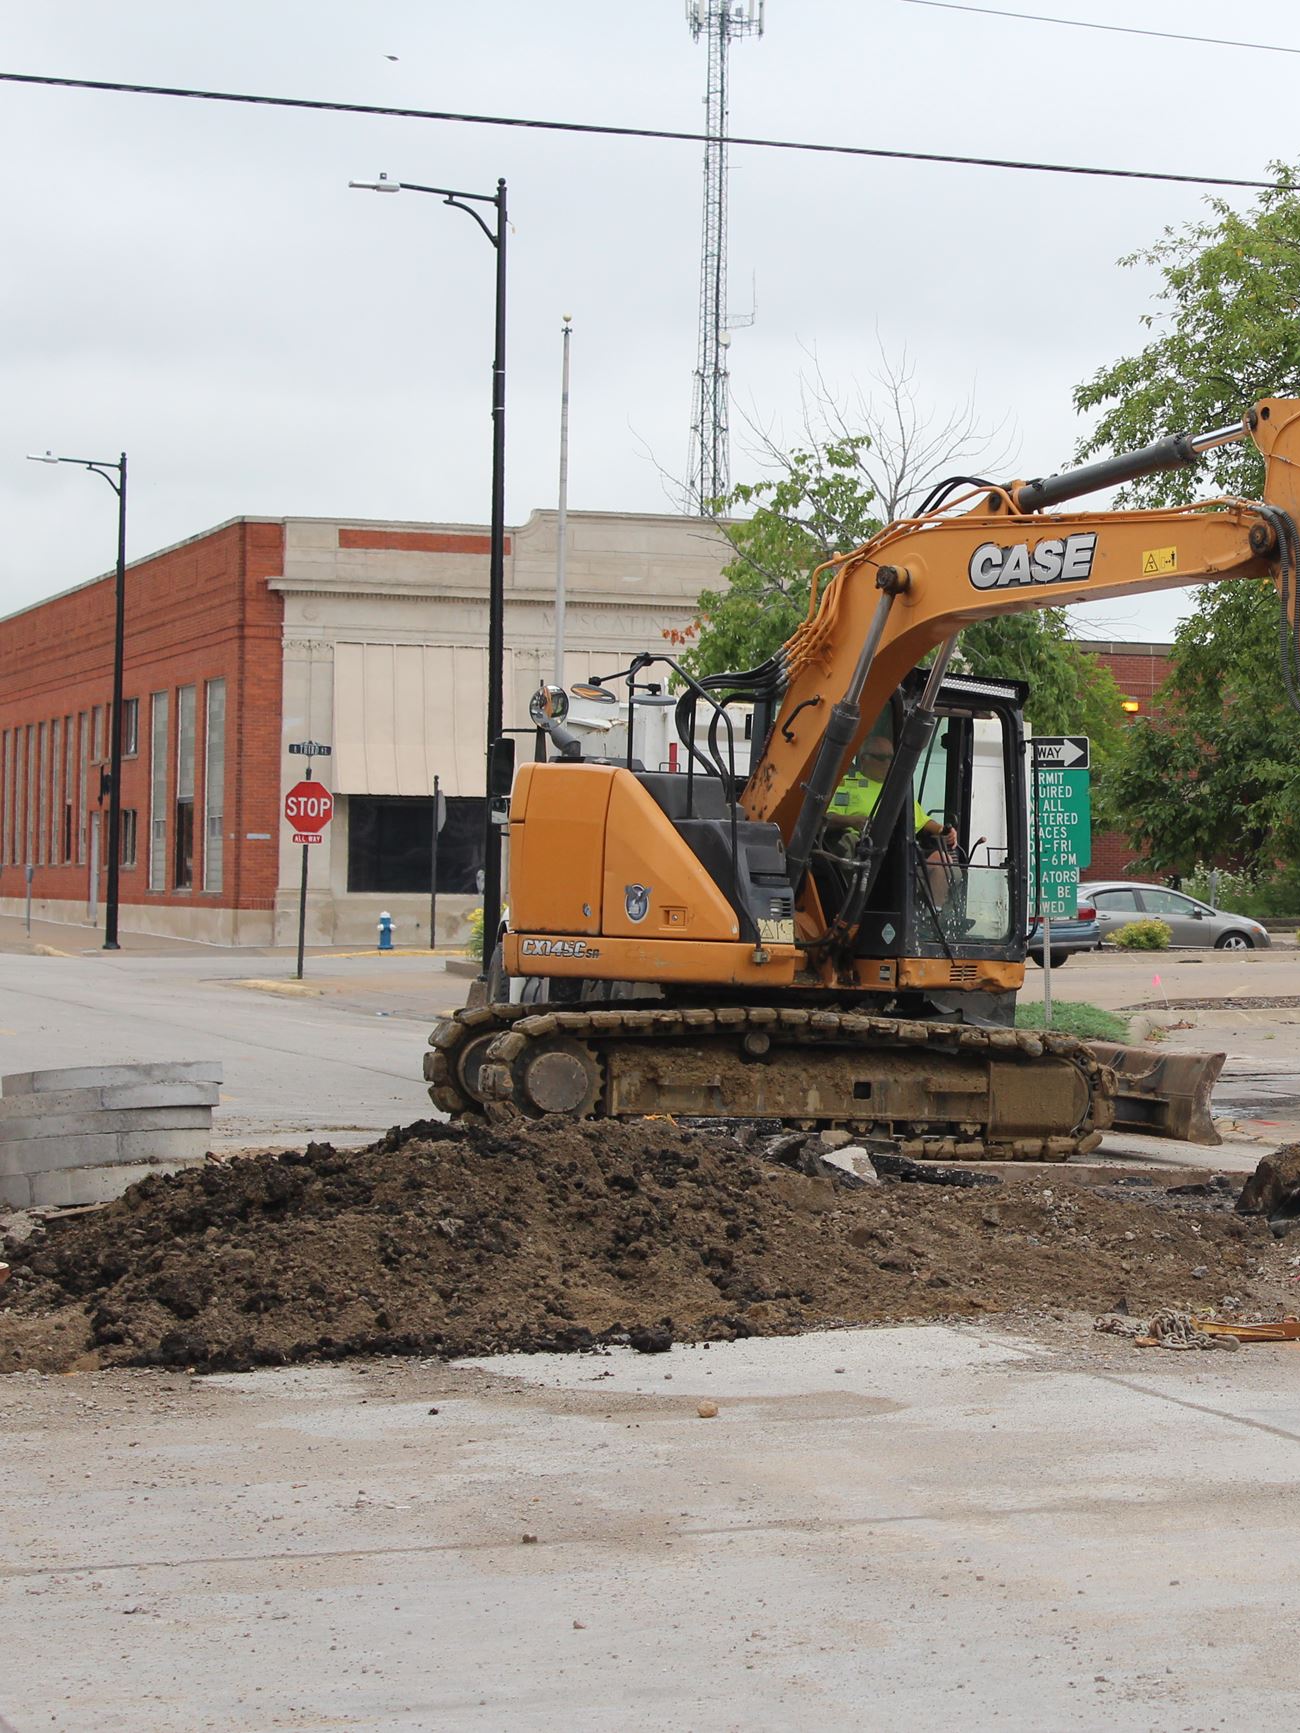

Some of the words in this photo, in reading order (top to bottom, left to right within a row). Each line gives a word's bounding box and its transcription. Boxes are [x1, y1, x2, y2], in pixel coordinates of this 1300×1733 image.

[969, 532, 1098, 590] CASE
[1037, 746, 1061, 759] WAY
[286, 796, 331, 818] STOP
[1043, 799, 1065, 812] ALL
[294, 835, 306, 843] ALL
[308, 835, 322, 843] WAY
[1057, 886, 1071, 899] BE
